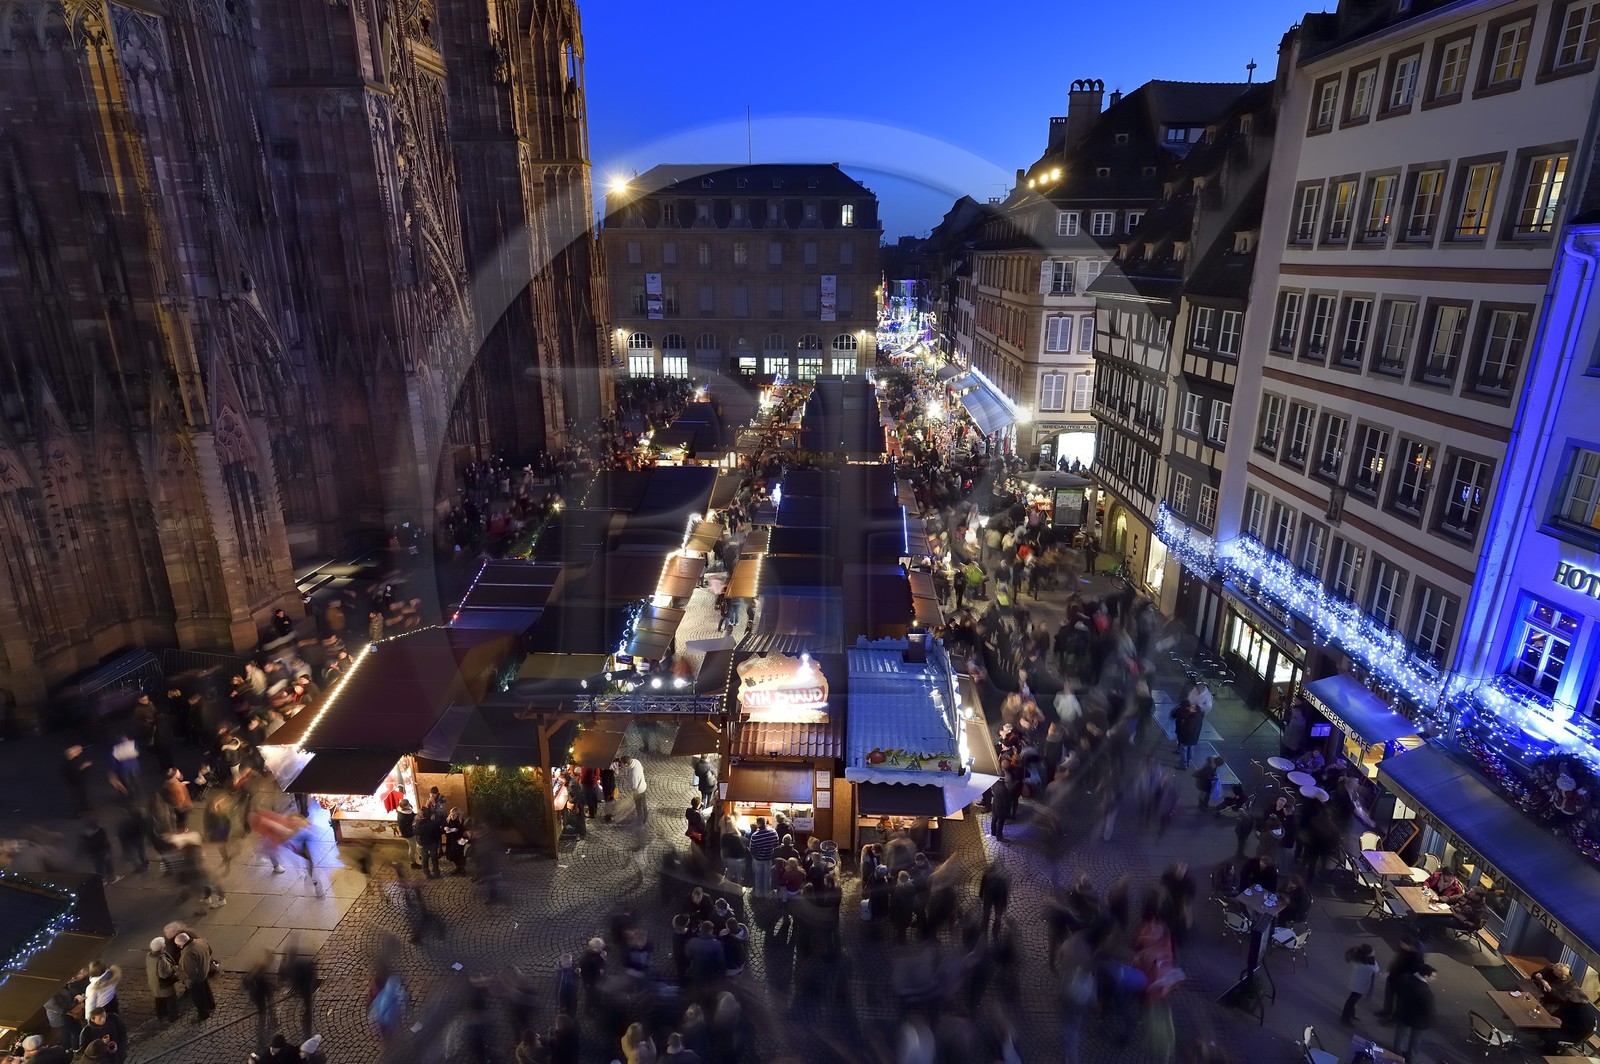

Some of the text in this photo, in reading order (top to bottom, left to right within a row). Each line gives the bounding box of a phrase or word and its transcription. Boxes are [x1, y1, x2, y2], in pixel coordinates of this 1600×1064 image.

[745, 690, 771, 706] VIN
[1302, 687, 1316, 706] BAR
[1319, 703, 1346, 732] CREPES
[1350, 730, 1371, 754] CAFE
[1418, 807, 1443, 833] CAFE
[1530, 904, 1558, 934] BAR
